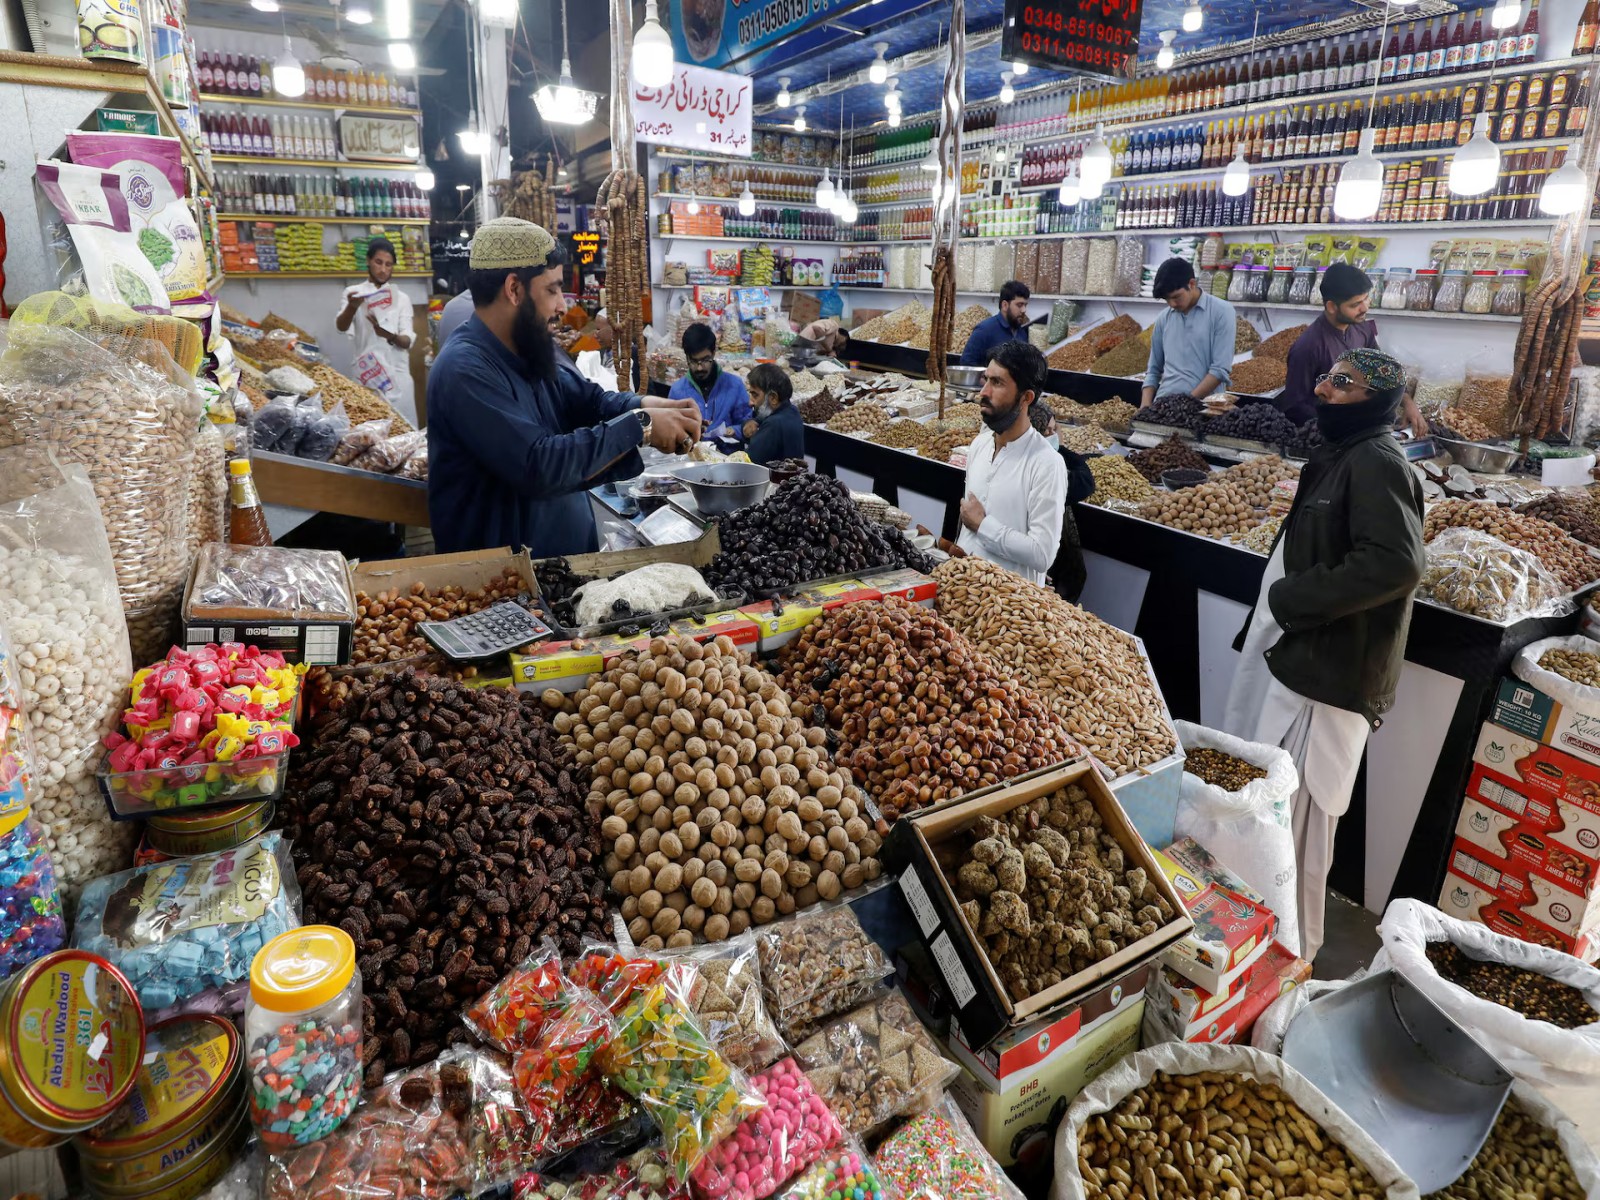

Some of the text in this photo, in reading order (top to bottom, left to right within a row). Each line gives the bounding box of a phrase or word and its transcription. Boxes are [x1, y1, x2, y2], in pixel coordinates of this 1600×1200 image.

[1024, 6, 1132, 47] 0348-8519067
[1022, 31, 1130, 71] 0311-0508157
[675, 71, 707, 112] ڈرائی
[708, 84, 748, 124] کراچی
[709, 131, 722, 142] 31
[1532, 712, 1542, 720] KG
[49, 971, 71, 1088] Abdul Wadood
[76, 1008, 93, 1047] 361
[1010, 1091, 1042, 1113] Processing
[1020, 1078, 1039, 1097] BHB
[1004, 1094, 1052, 1127] Packaging Dates
[159, 1125, 212, 1170] Abdul
